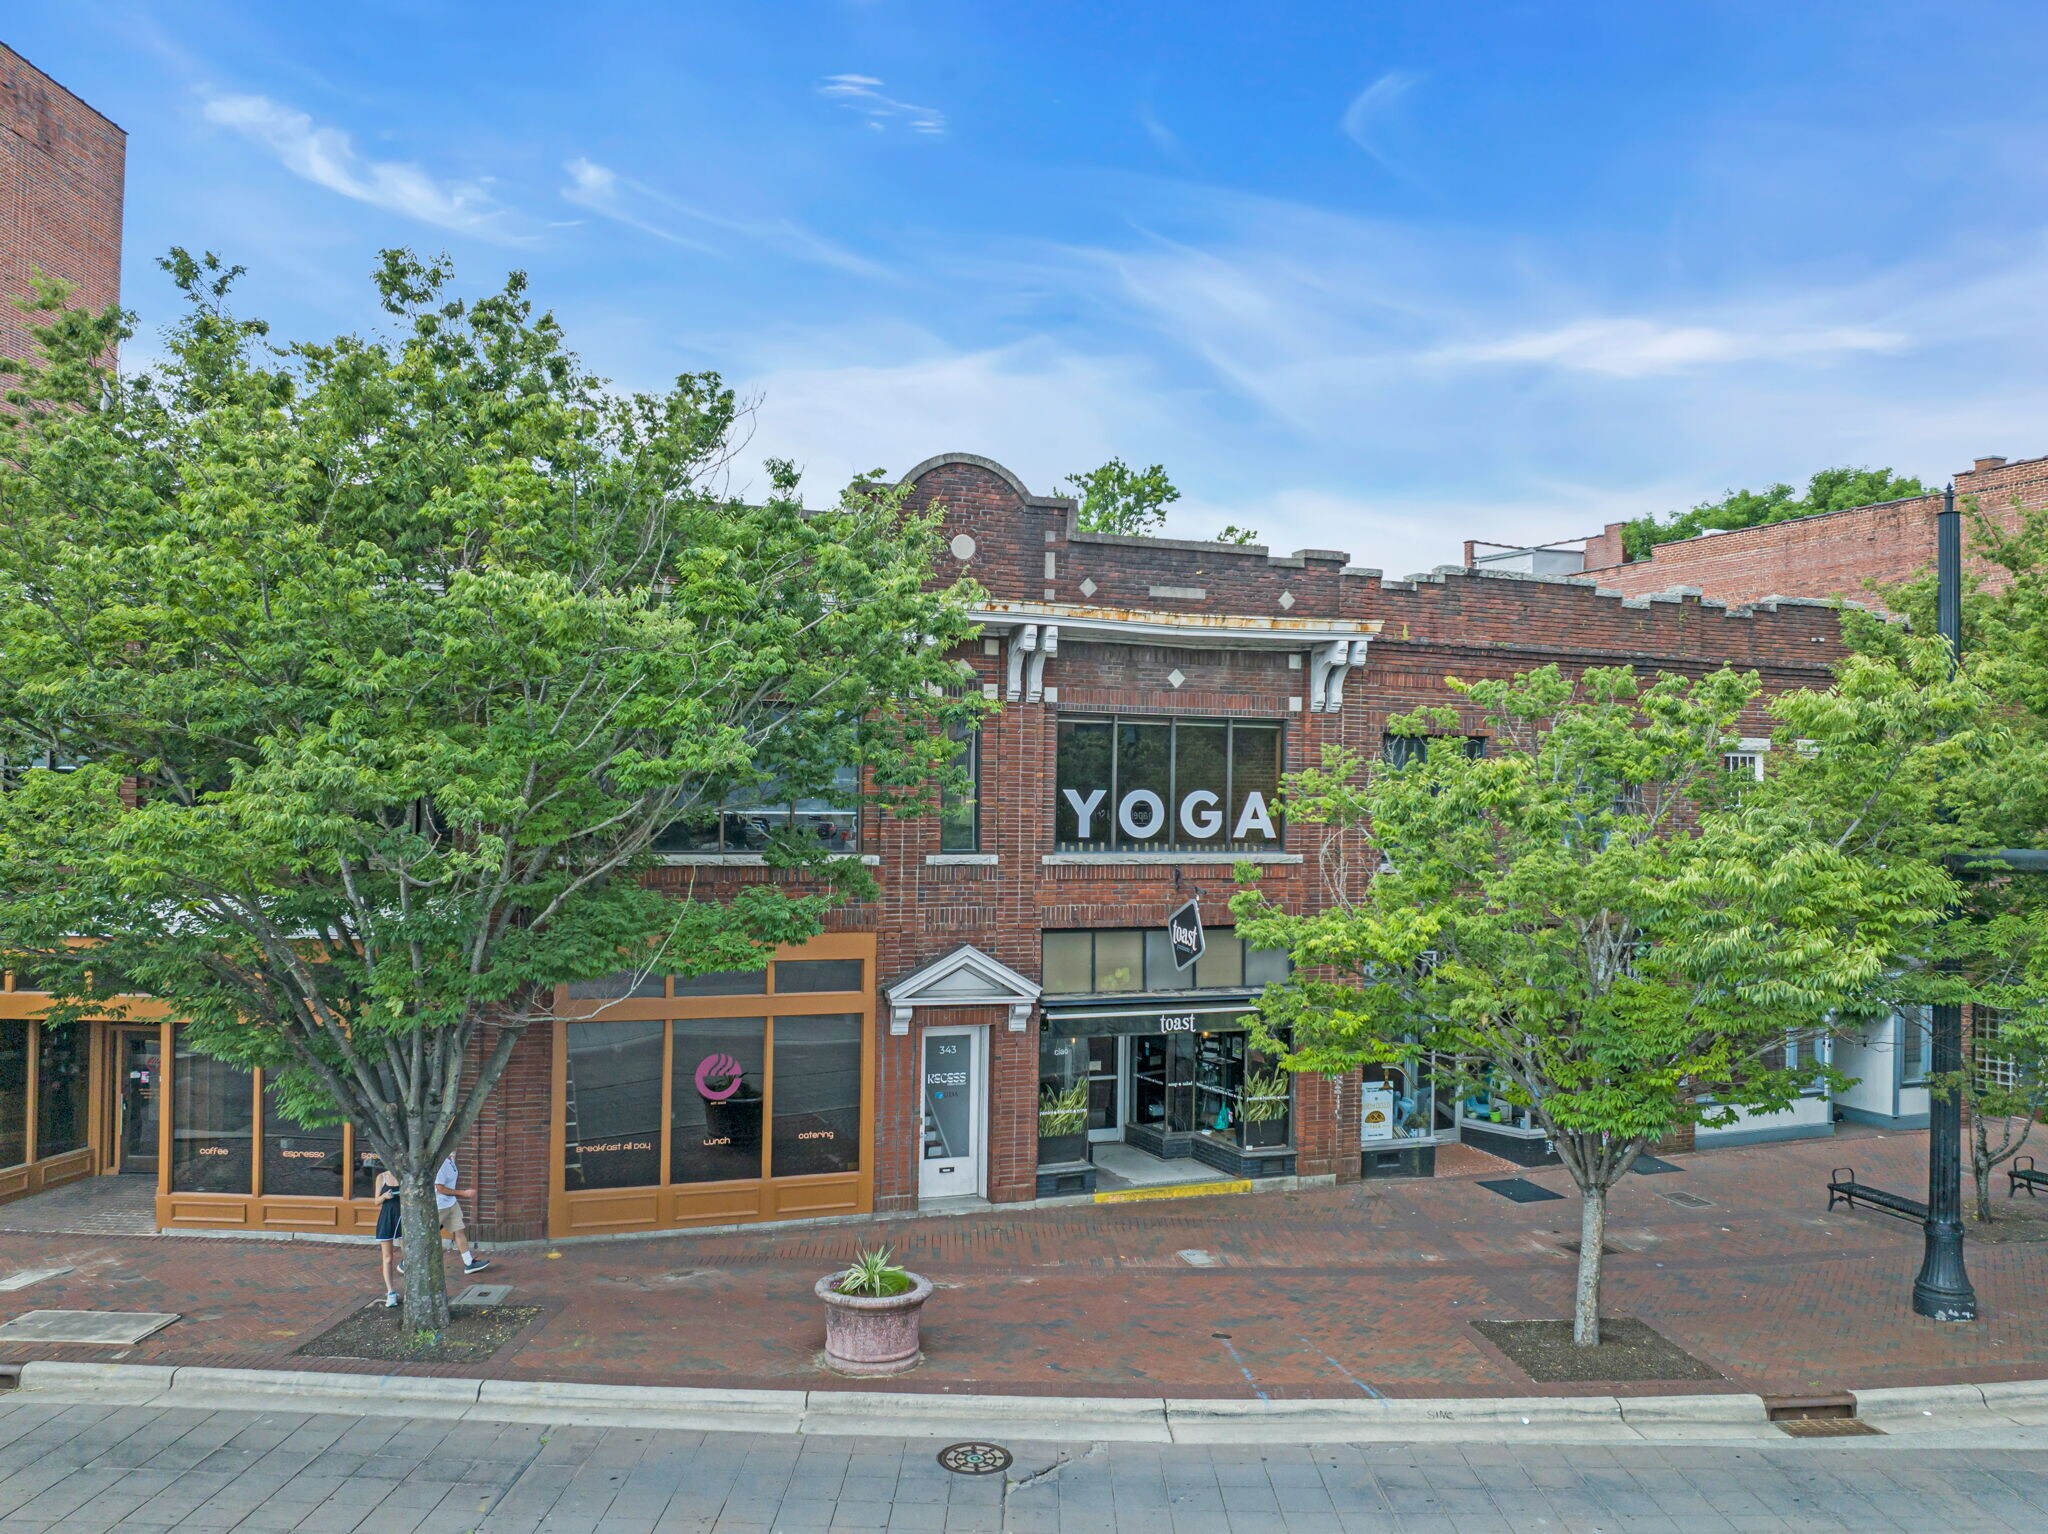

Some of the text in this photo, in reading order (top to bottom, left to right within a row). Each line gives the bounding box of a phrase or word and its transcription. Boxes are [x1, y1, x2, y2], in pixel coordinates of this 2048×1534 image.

[1062, 789, 1277, 839] YOGA
[1172, 919, 1198, 952] toast
[1159, 1013, 1197, 1034] toast
[939, 1045, 957, 1055] 343
[927, 1072, 967, 1085] RECESS
[798, 1130, 834, 1140] catering
[703, 1136, 731, 1146] Lunch
[199, 1147, 229, 1156] coffee
[282, 1150, 325, 1160] espresso
